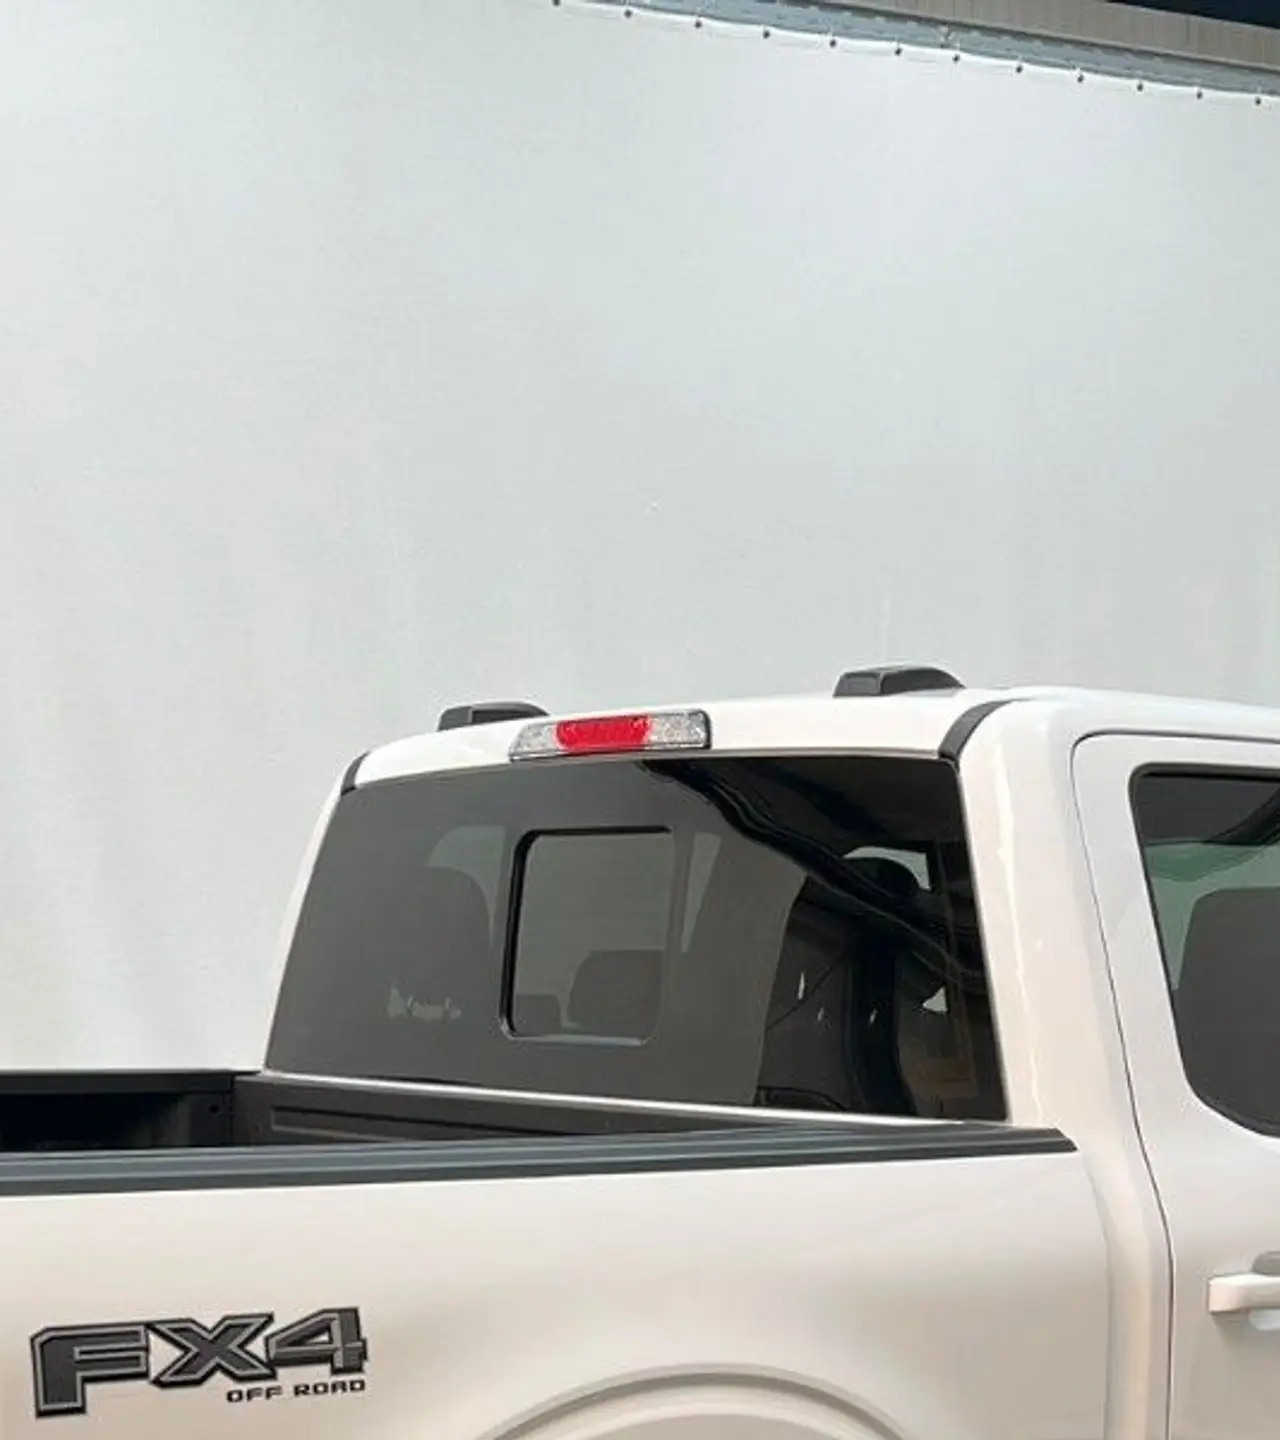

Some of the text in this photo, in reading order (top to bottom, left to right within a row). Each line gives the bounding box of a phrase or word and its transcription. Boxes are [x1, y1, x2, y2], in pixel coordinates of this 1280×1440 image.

[31, 1307, 368, 1419] FX4
[226, 1379, 366, 1403] OFF ROAD
